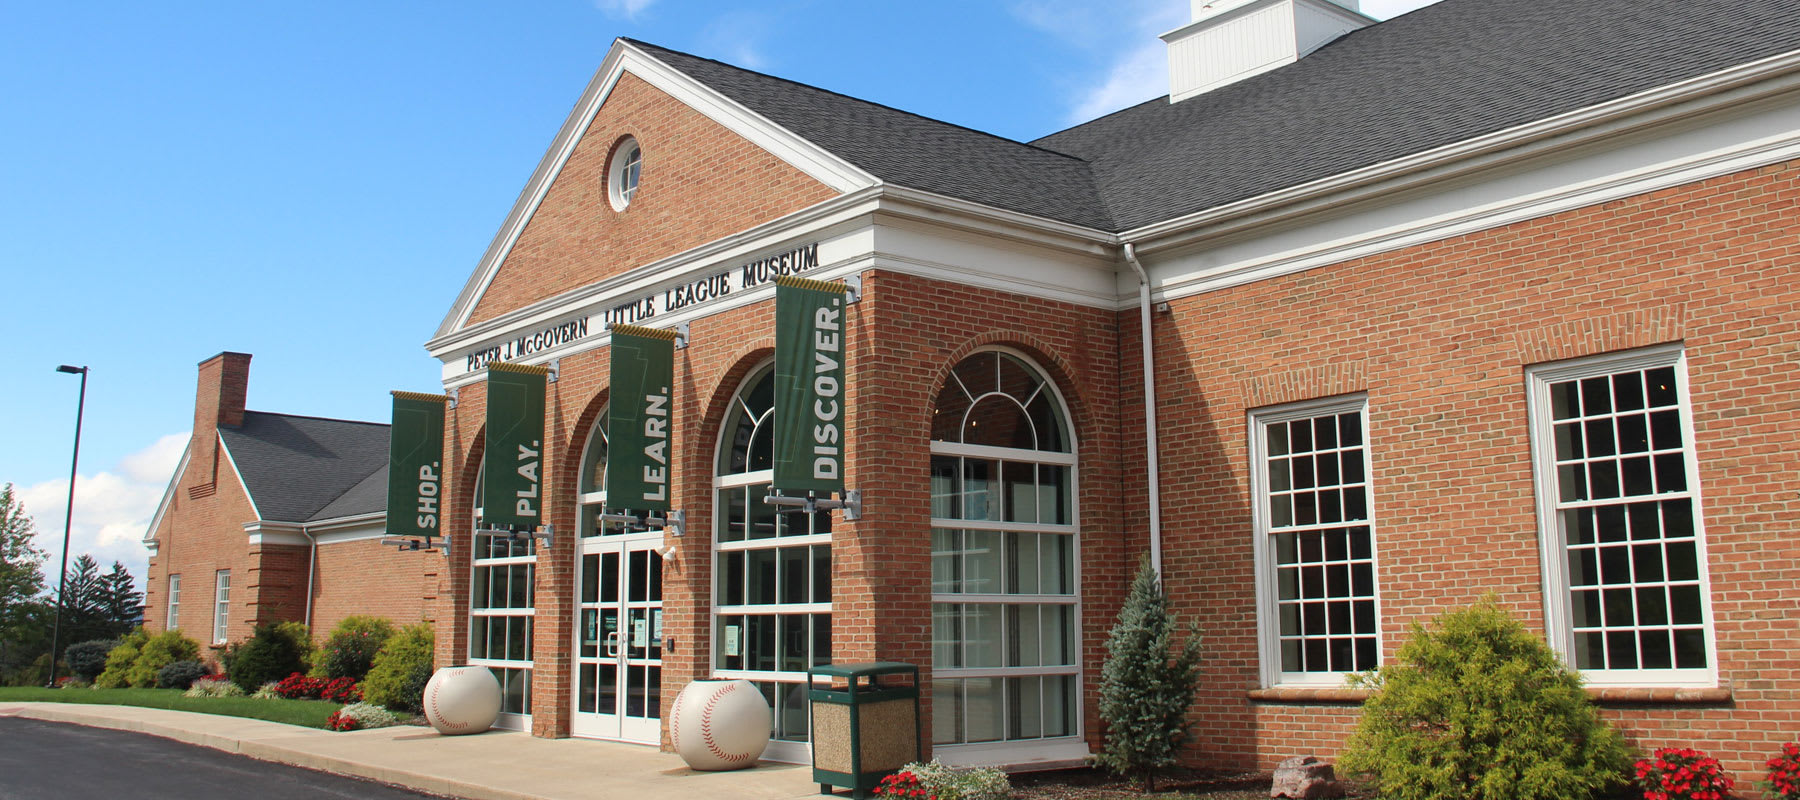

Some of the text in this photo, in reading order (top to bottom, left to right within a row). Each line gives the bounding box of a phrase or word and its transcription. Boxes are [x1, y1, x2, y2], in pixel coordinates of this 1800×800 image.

[467, 347, 501, 371] PETER
[605, 296, 655, 325] LITTLE
[665, 272, 730, 311] LEAGUE
[742, 243, 819, 288] MUSEUM
[643, 386, 668, 501] LEARN.
[813, 297, 840, 480] DISCOVER.
[417, 461, 439, 529] SHOP.
[516, 440, 539, 517] PLAY.
